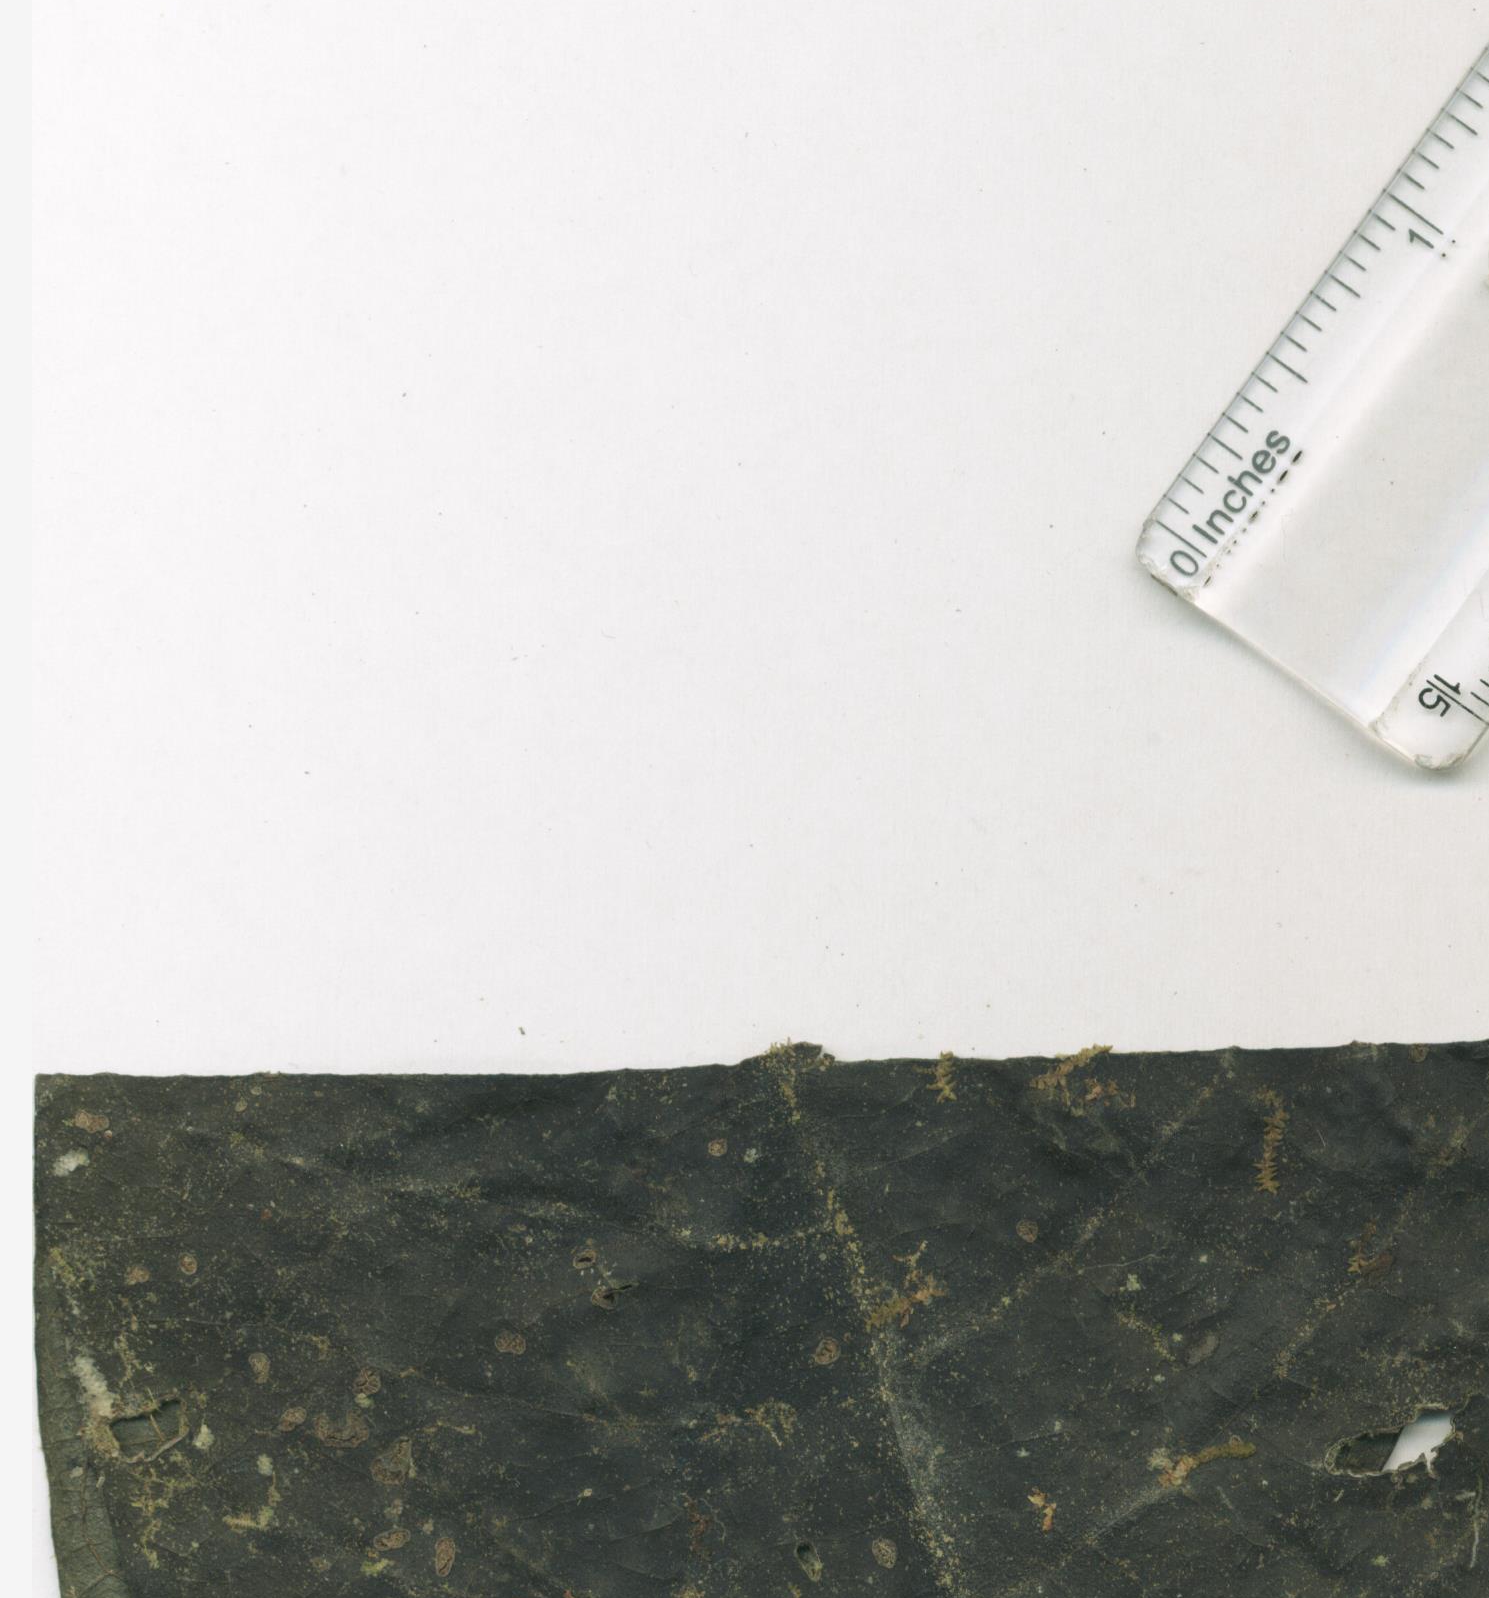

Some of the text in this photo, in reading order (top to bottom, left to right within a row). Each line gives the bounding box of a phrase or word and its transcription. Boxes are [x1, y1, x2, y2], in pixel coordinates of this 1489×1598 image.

[1407, 228, 1435, 249] 1
[1199, 429, 1292, 548] Inches
[1417, 674, 1462, 718] 15
